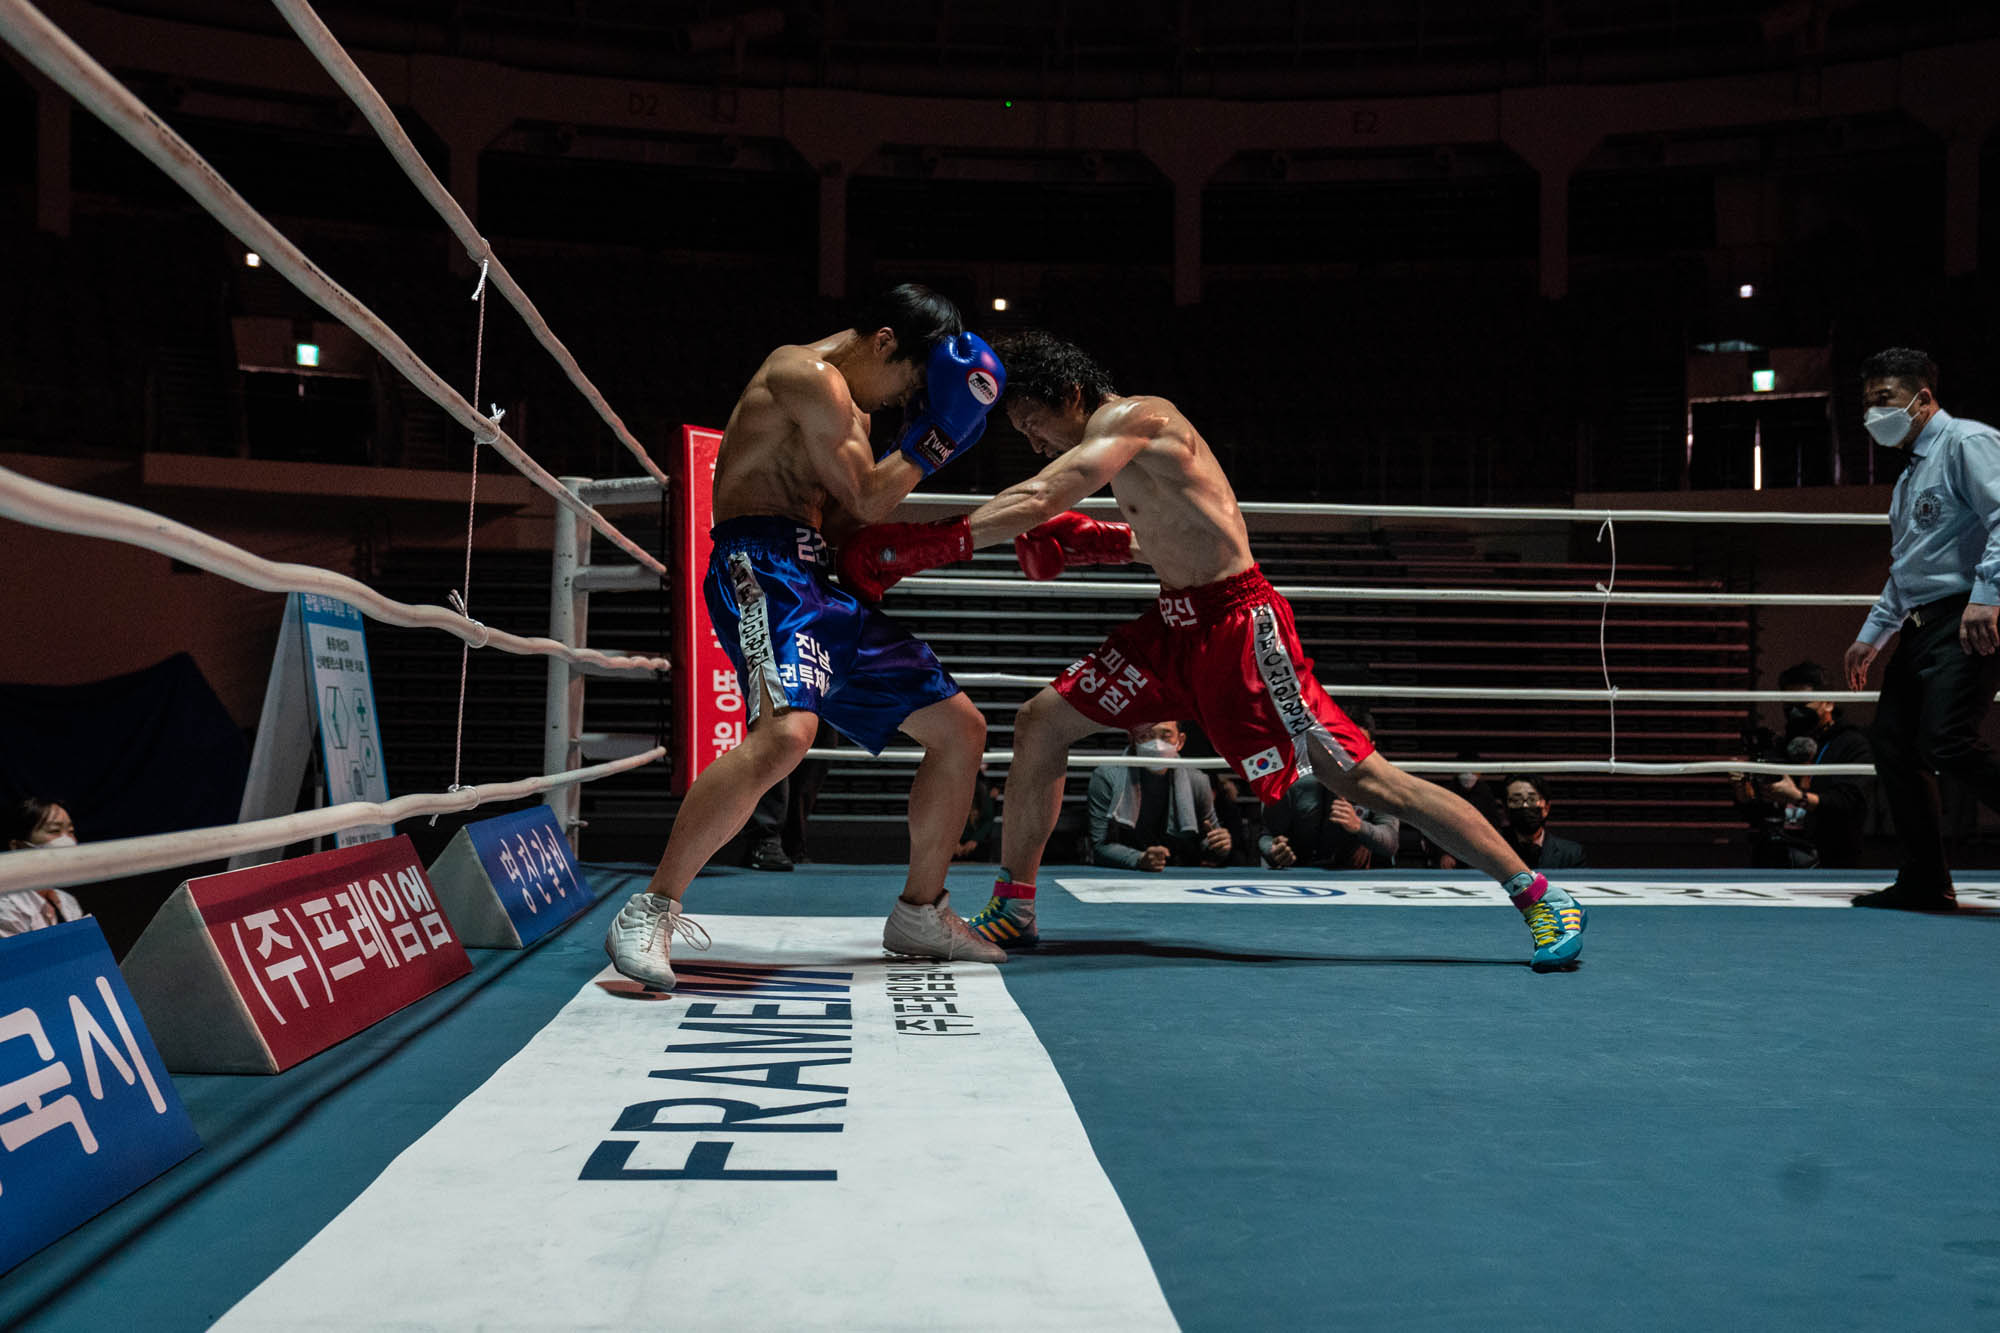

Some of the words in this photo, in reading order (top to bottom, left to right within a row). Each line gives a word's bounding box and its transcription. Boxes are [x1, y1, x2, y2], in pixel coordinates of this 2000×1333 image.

[1087, 644, 1149, 697] 피릿
[499, 824, 579, 915] 명진갈비
[231, 865, 453, 1025] (주)프레임엠
[0, 976, 167, 1190] 국시
